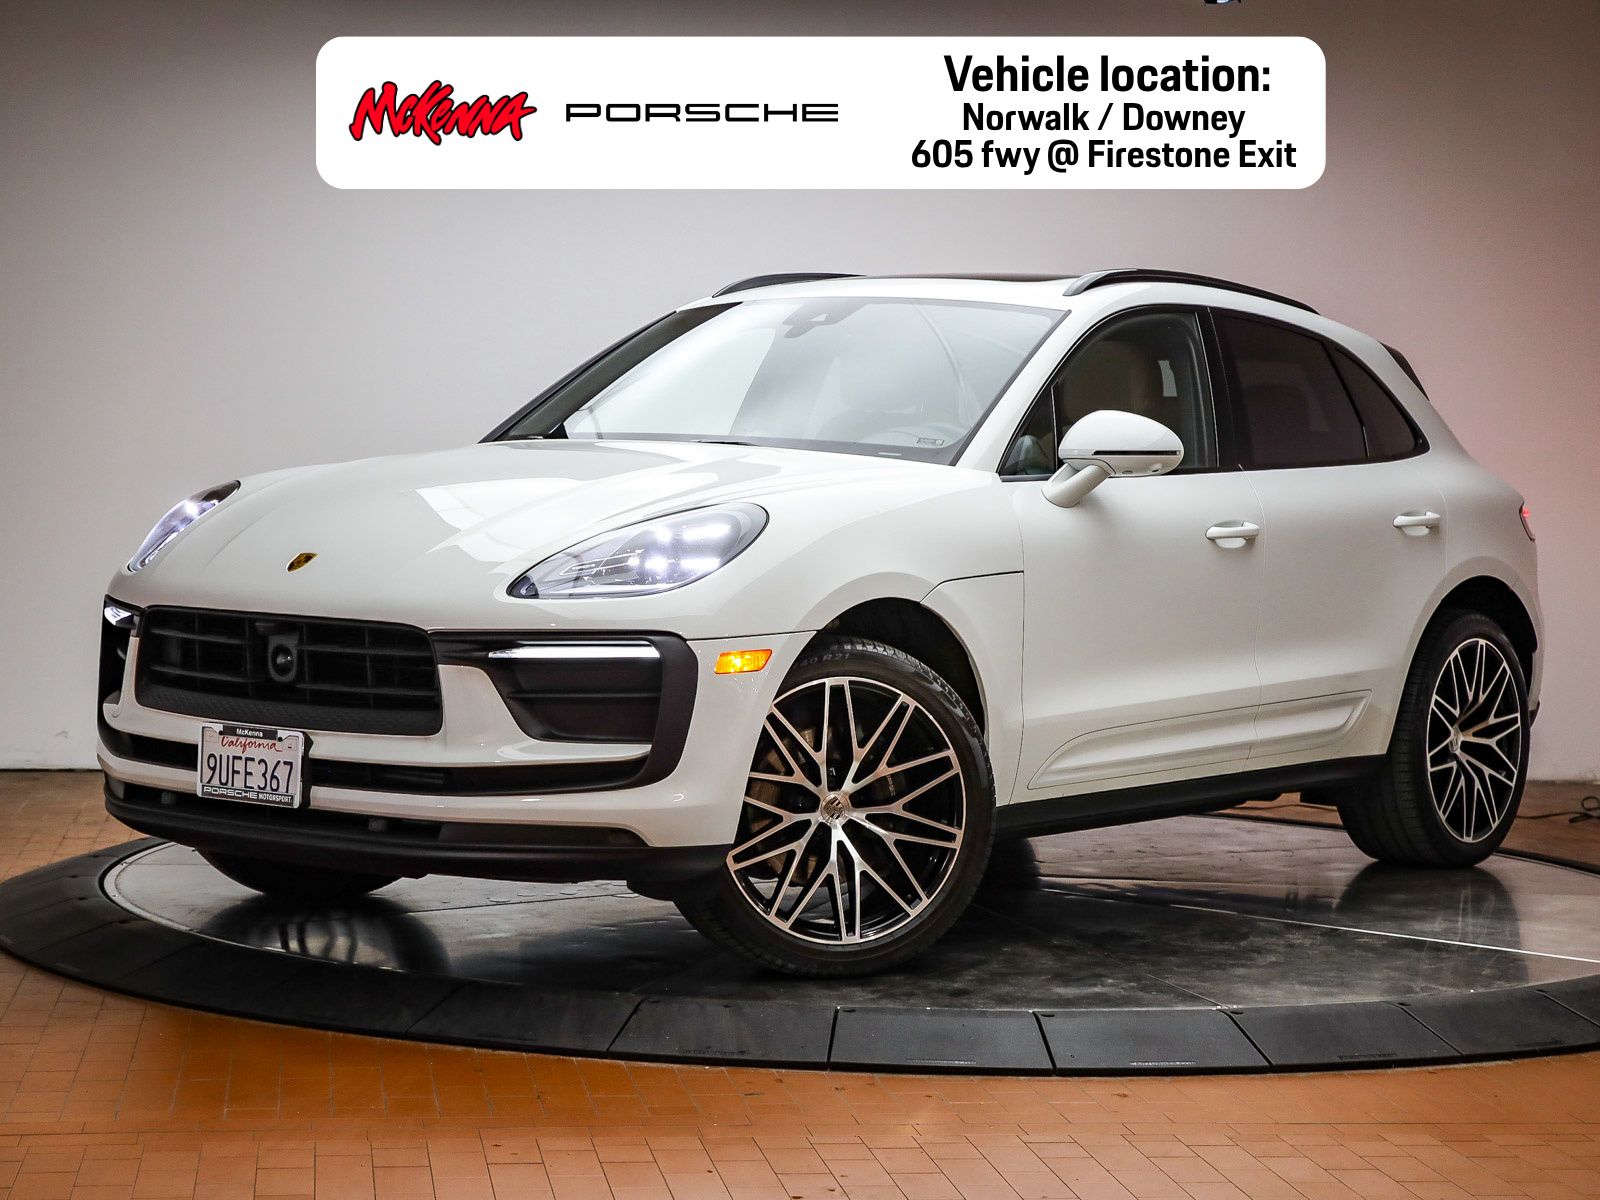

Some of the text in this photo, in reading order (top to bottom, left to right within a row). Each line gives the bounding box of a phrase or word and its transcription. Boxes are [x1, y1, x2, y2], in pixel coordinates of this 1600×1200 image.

[236, 728, 263, 738] McKenna
[221, 736, 283, 754] California
[206, 753, 294, 794] 9UFE367
[203, 786, 258, 799] PORSCHE
